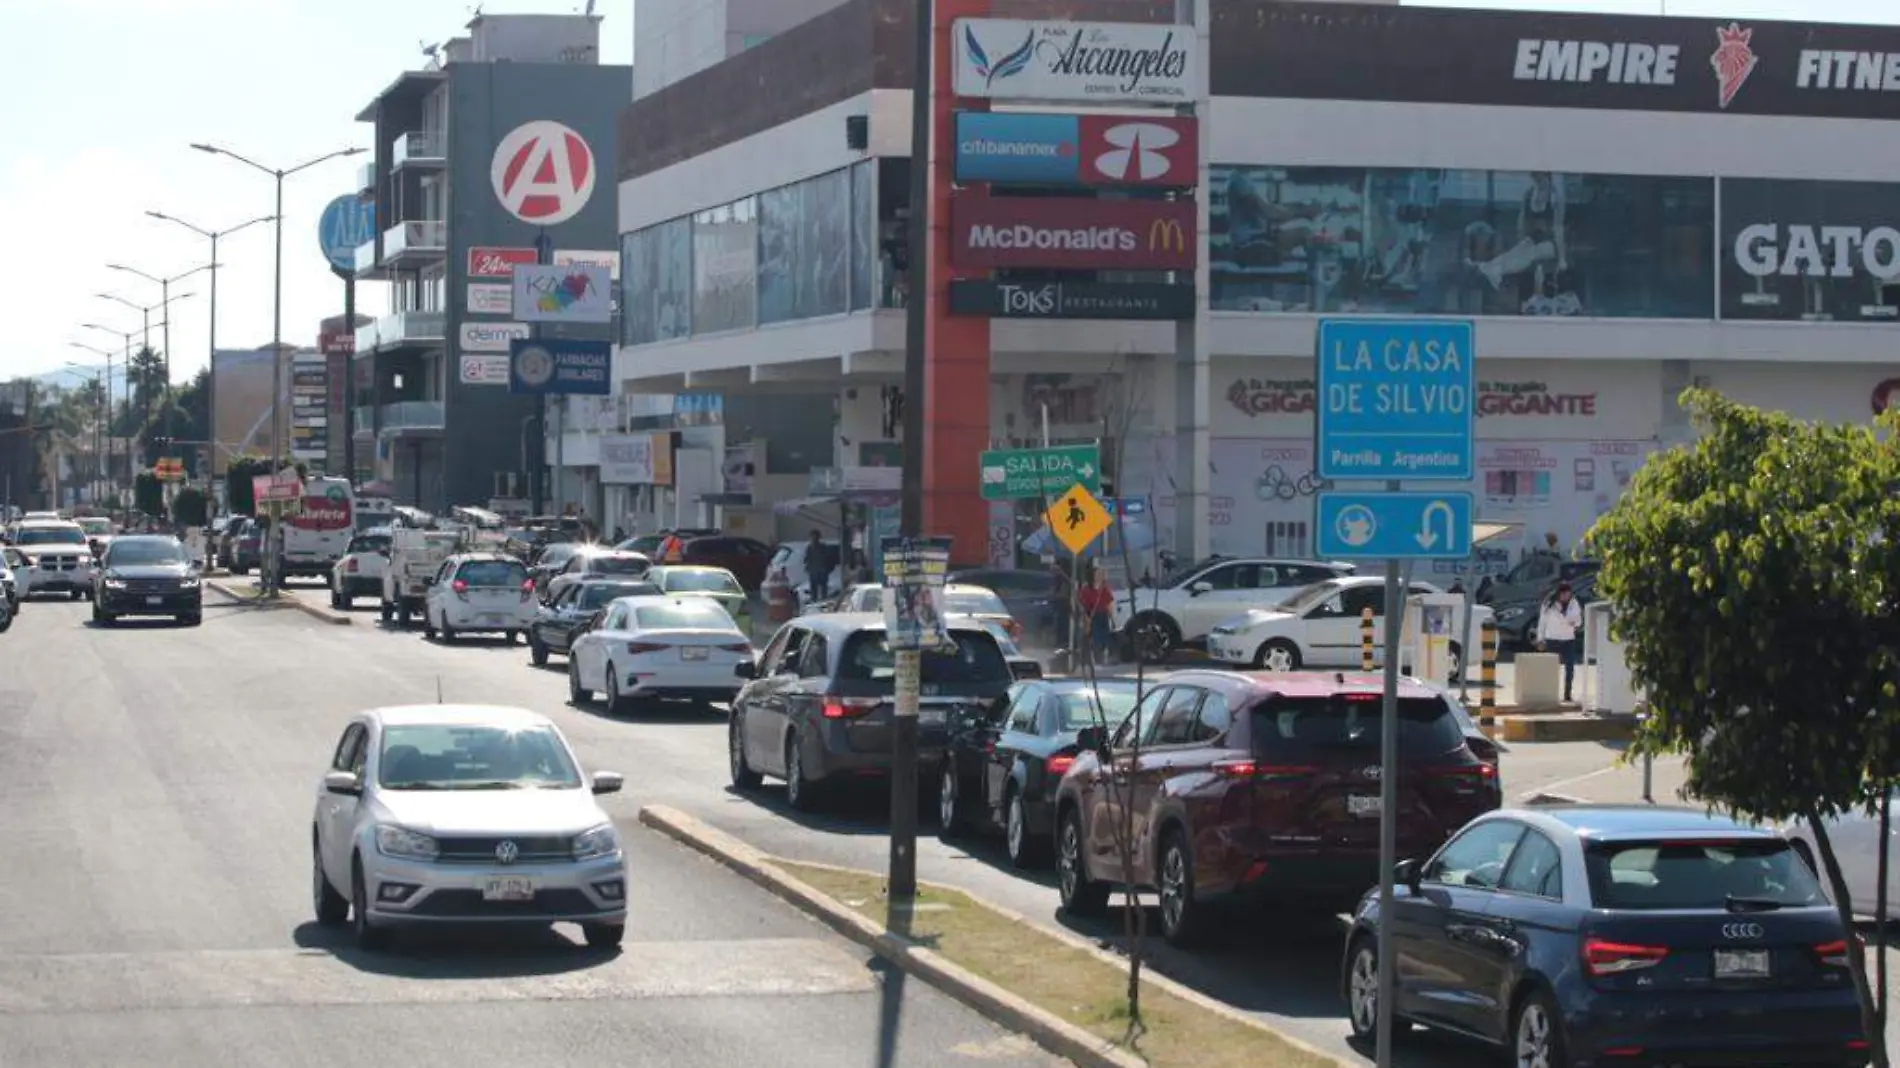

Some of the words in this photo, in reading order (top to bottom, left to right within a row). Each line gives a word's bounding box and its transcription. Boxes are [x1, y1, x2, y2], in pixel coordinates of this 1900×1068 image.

[1035, 28, 1187, 93] Arcangeles
[1513, 38, 1680, 85] EMPIRE
[1796, 49, 1900, 90] FITNE
[961, 139, 1058, 157] citibanamex
[968, 224, 1136, 251] McDonald's
[1734, 223, 1900, 281] GATO
[1336, 341, 1372, 372] LA
[1384, 340, 1461, 372] CASA
[1329, 383, 1363, 413] DE
[1376, 383, 1465, 413] SILVIO
[1478, 394, 1595, 415] GIGANTE
[1006, 454, 1073, 474] SALIDA
[1331, 450, 1382, 466] Parrilla
[1392, 451, 1460, 469] Argentina
